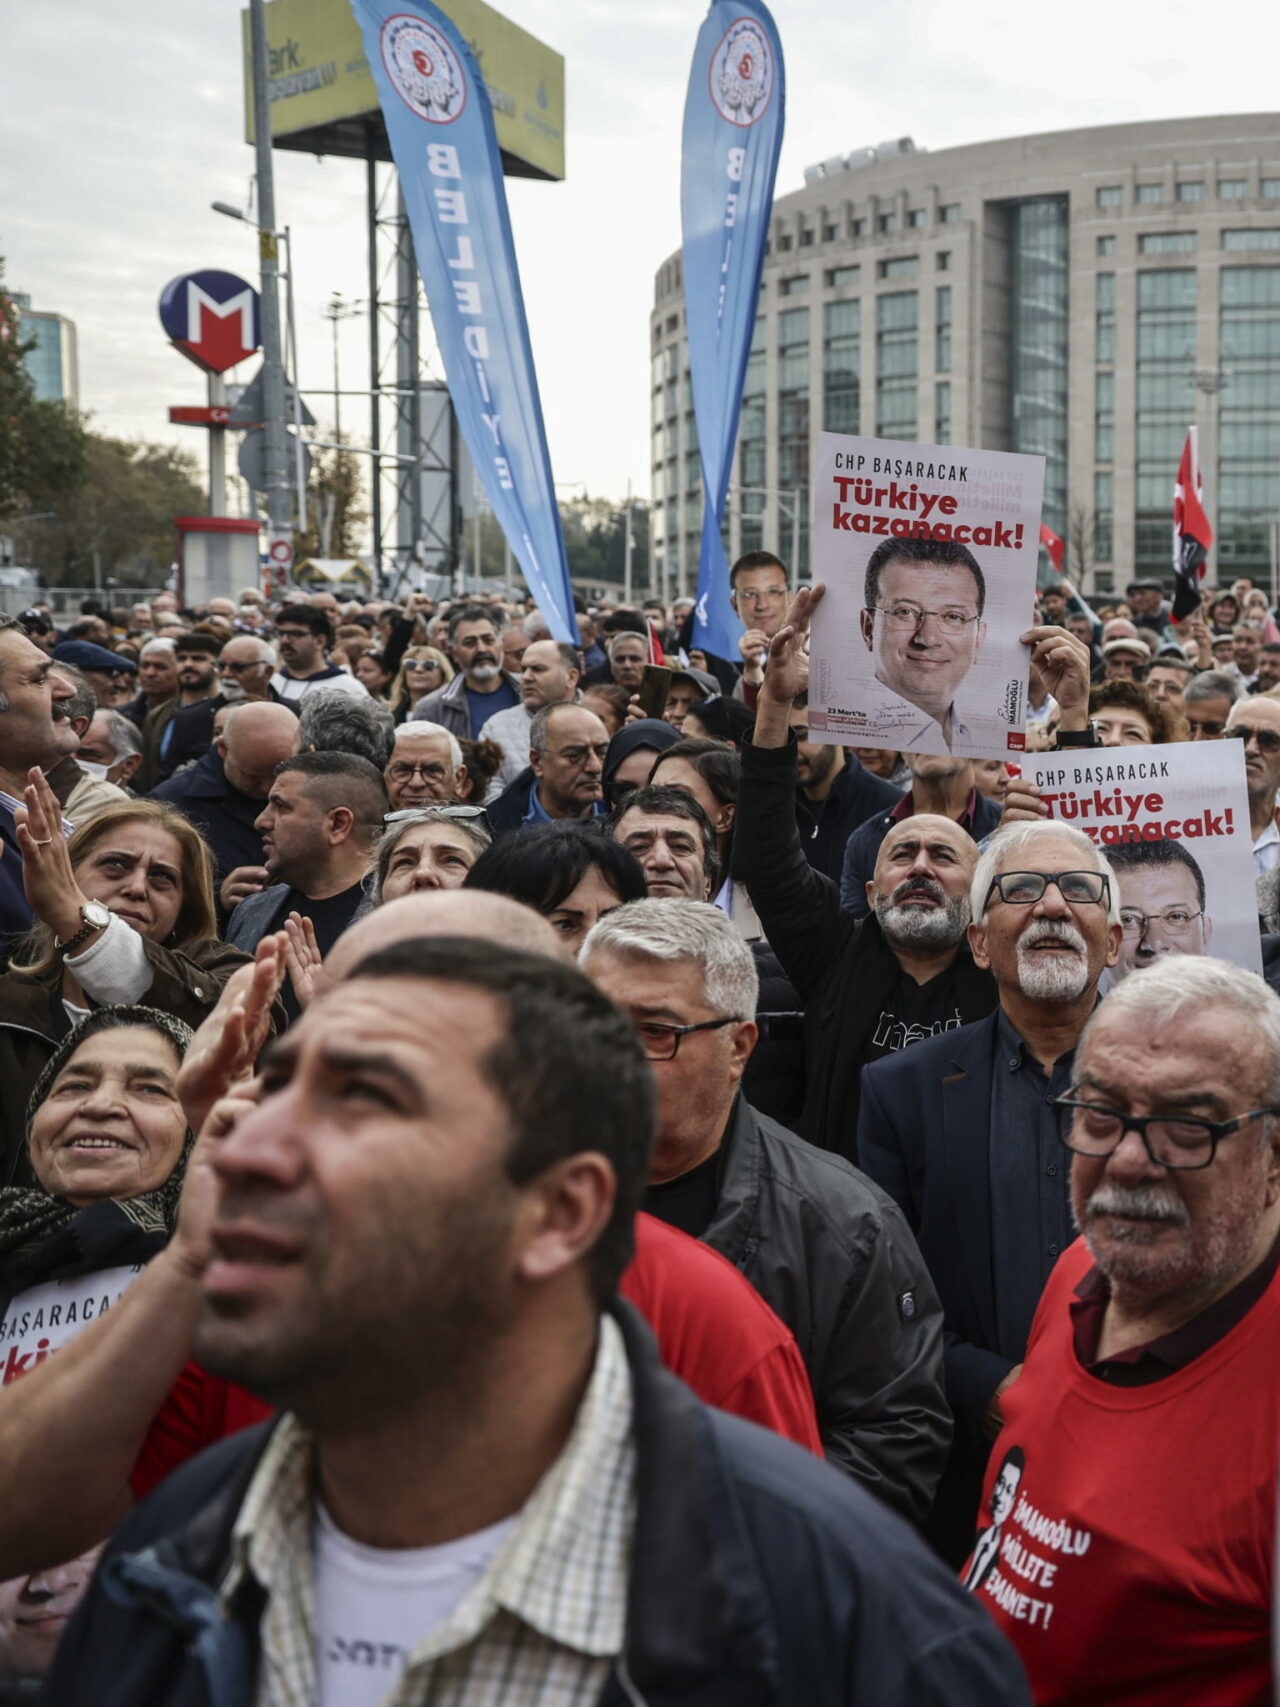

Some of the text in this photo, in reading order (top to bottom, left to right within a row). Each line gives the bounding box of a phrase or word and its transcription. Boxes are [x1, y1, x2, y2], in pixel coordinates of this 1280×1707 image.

[835, 452, 866, 471] CHP
[873, 457, 969, 483] BAŞARACAK
[833, 476, 958, 519] Türkiye
[833, 503, 1025, 550] kazanacak!
[1035, 761, 1170, 788] CHP BAŞARACAK
[1040, 787, 1165, 822] Türkiye
[1013, 1490, 1091, 1557] İMAMOĞLU
[1000, 1533, 1058, 1588] MİLLETE
[984, 1566, 1054, 1630] EMANET!
